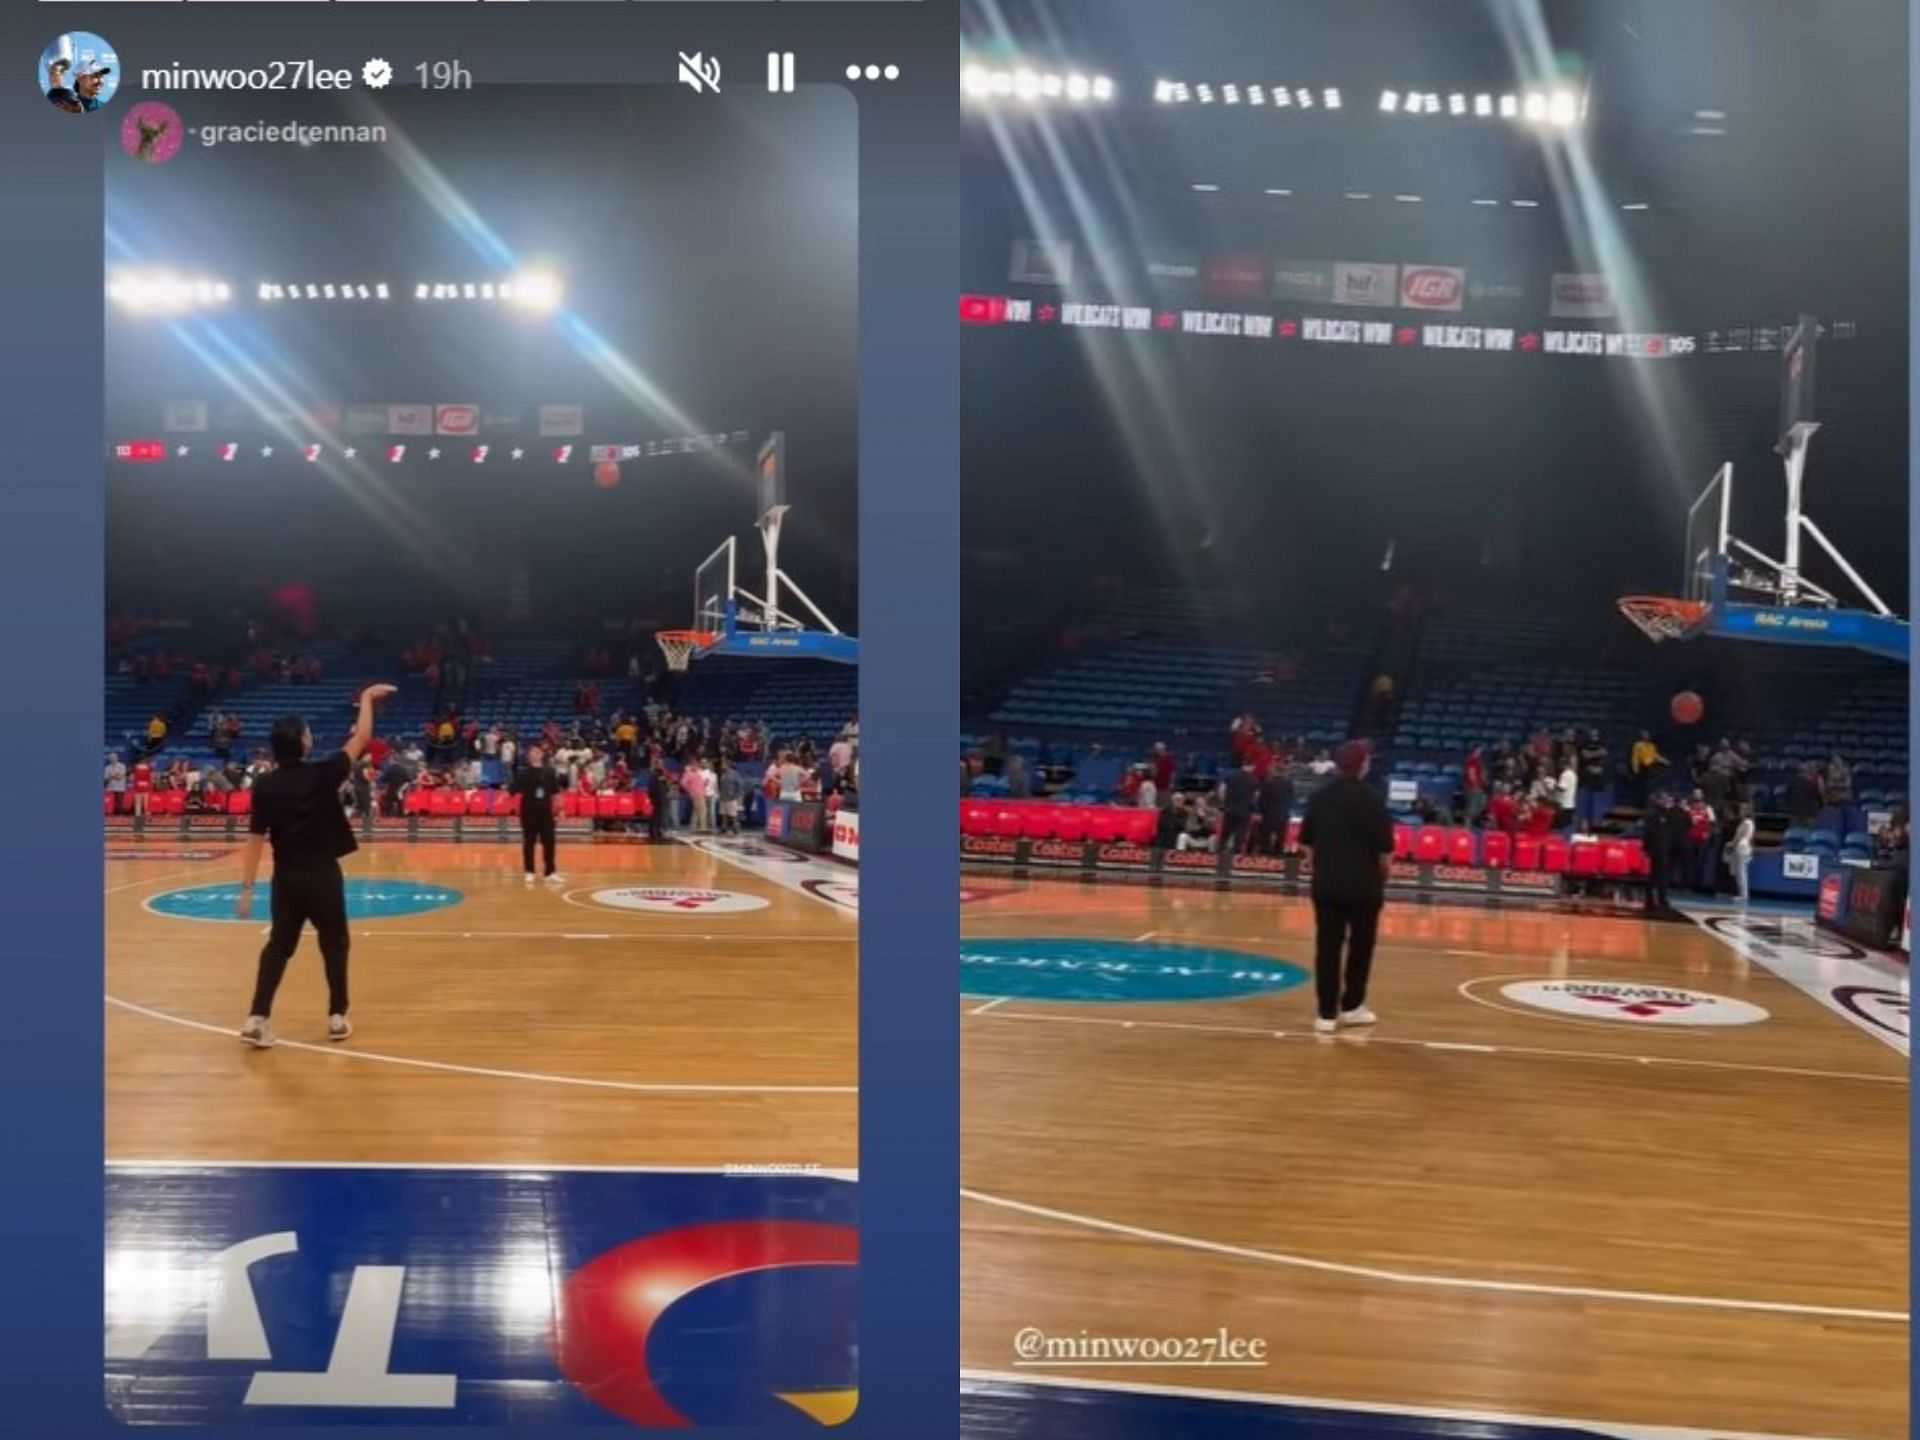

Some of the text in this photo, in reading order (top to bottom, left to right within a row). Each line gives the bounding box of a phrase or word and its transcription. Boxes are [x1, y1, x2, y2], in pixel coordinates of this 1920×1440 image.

[1407, 272, 1458, 300] IGA
[1061, 303, 1120, 327] WILDCATS
[1182, 311, 1240, 335] WILDCATS
[1302, 318, 1360, 342] WILDCATS
[1422, 325, 1481, 348] WILDCATS
[964, 838, 1016, 852] Coates
[1032, 841, 1084, 857] Coates
[1166, 851, 1217, 867] Coates
[1232, 854, 1285, 870] Coates
